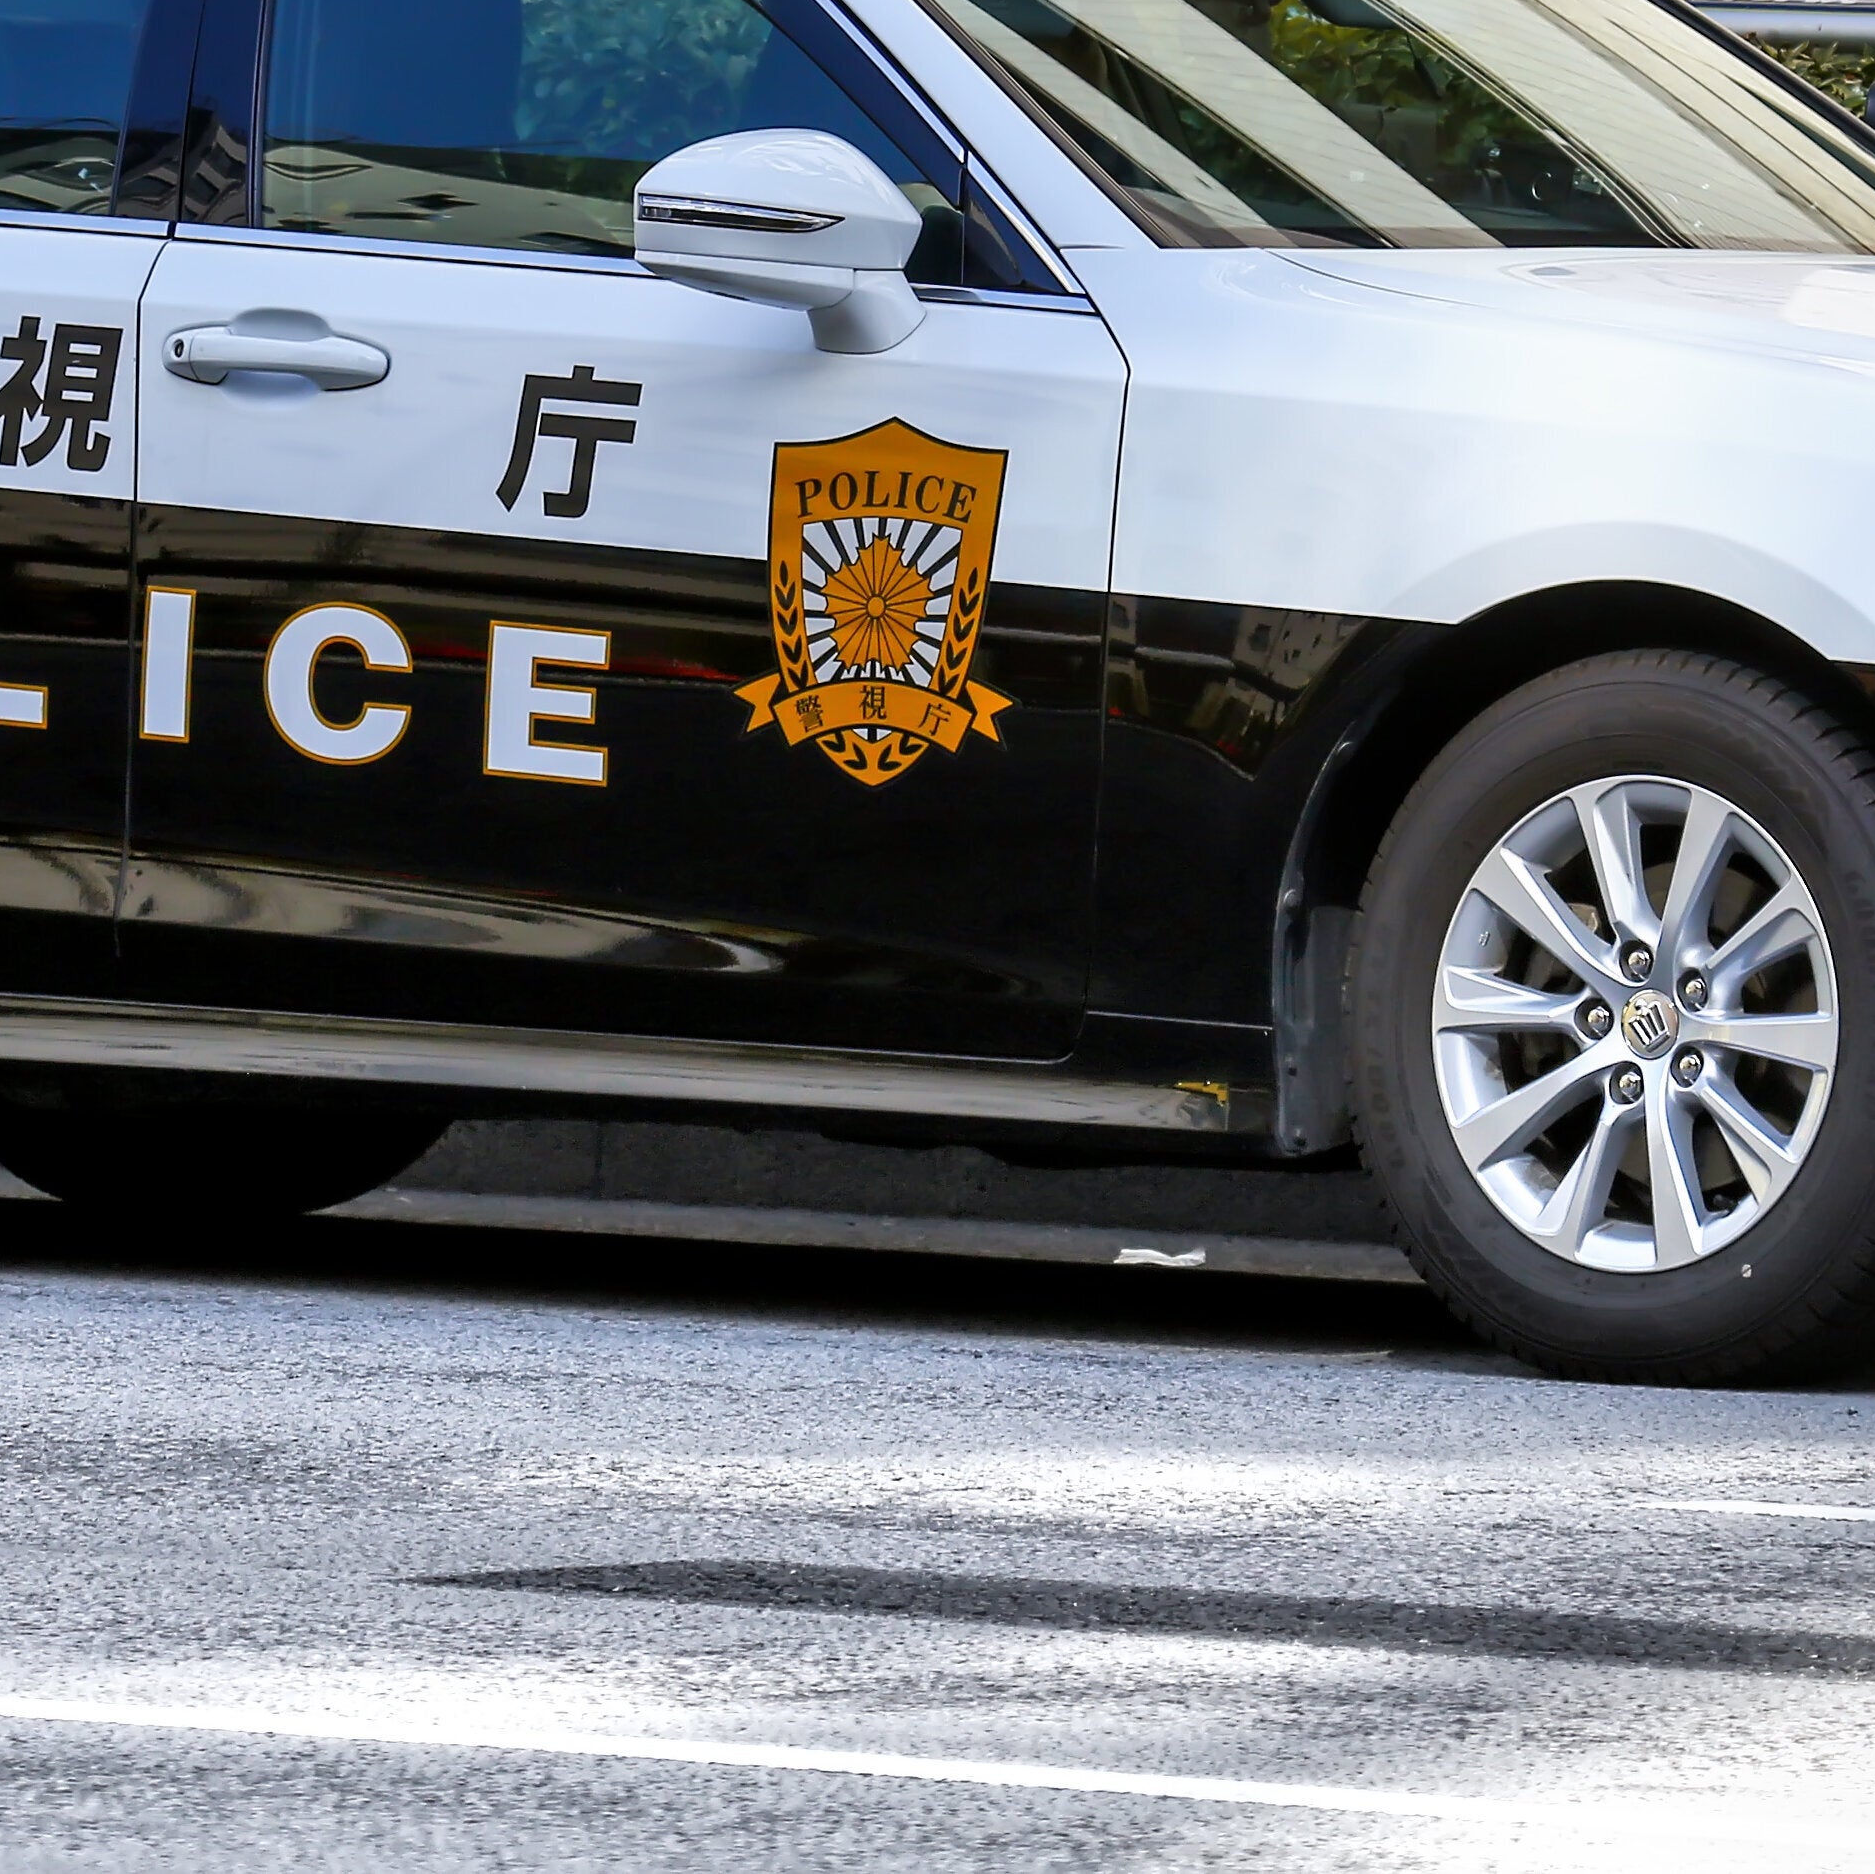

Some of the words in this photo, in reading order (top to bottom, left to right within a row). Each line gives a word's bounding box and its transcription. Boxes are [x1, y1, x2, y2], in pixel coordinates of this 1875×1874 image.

[795, 470, 978, 524] POLICE
[793, 685, 952, 736] 警視庁
